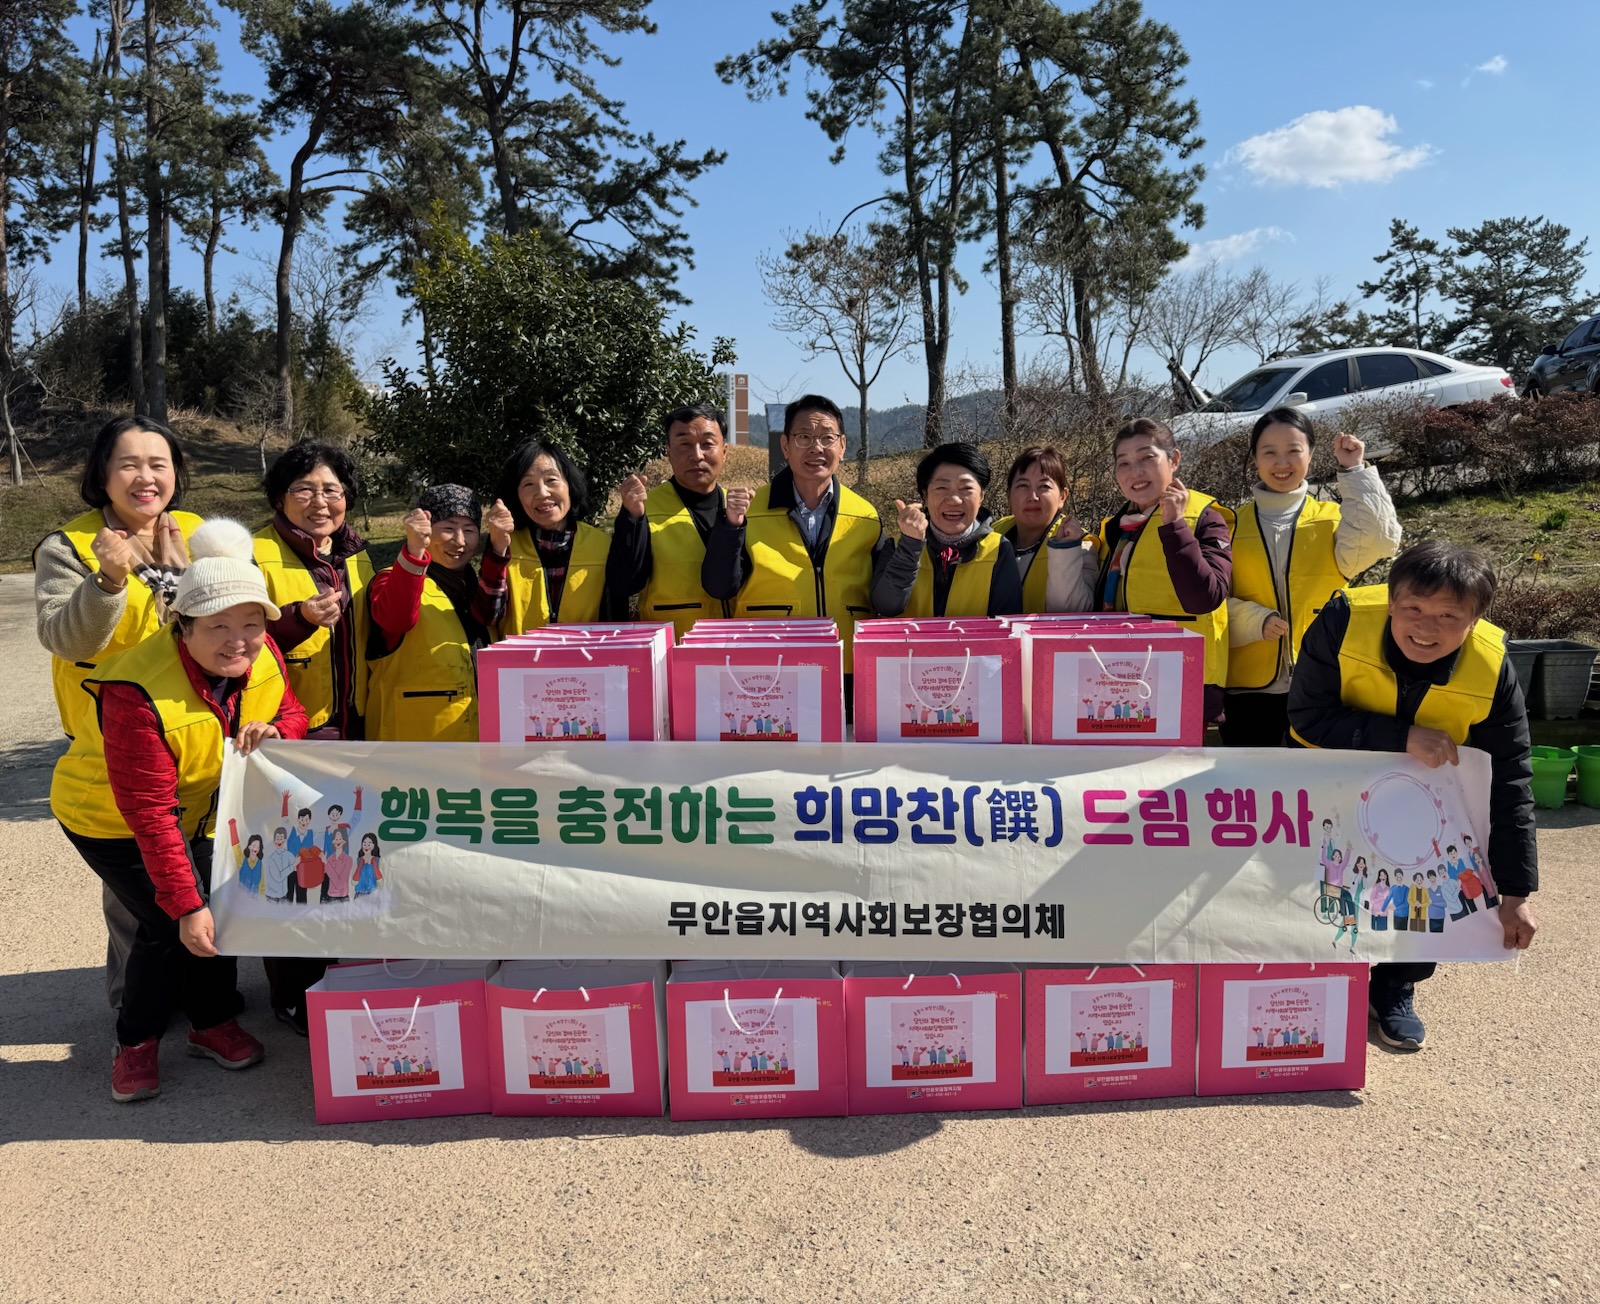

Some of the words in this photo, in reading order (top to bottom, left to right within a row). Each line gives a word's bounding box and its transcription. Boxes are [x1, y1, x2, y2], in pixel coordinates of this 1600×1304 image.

[377, 787, 540, 845] 행복을
[558, 786, 775, 844] 충전하는
[795, 786, 1062, 847] 희망찬(饌)
[1083, 788, 1189, 846] 드림
[1205, 788, 1313, 847] 행사
[668, 902, 1064, 938] 무안읍지역사회보장협의체
